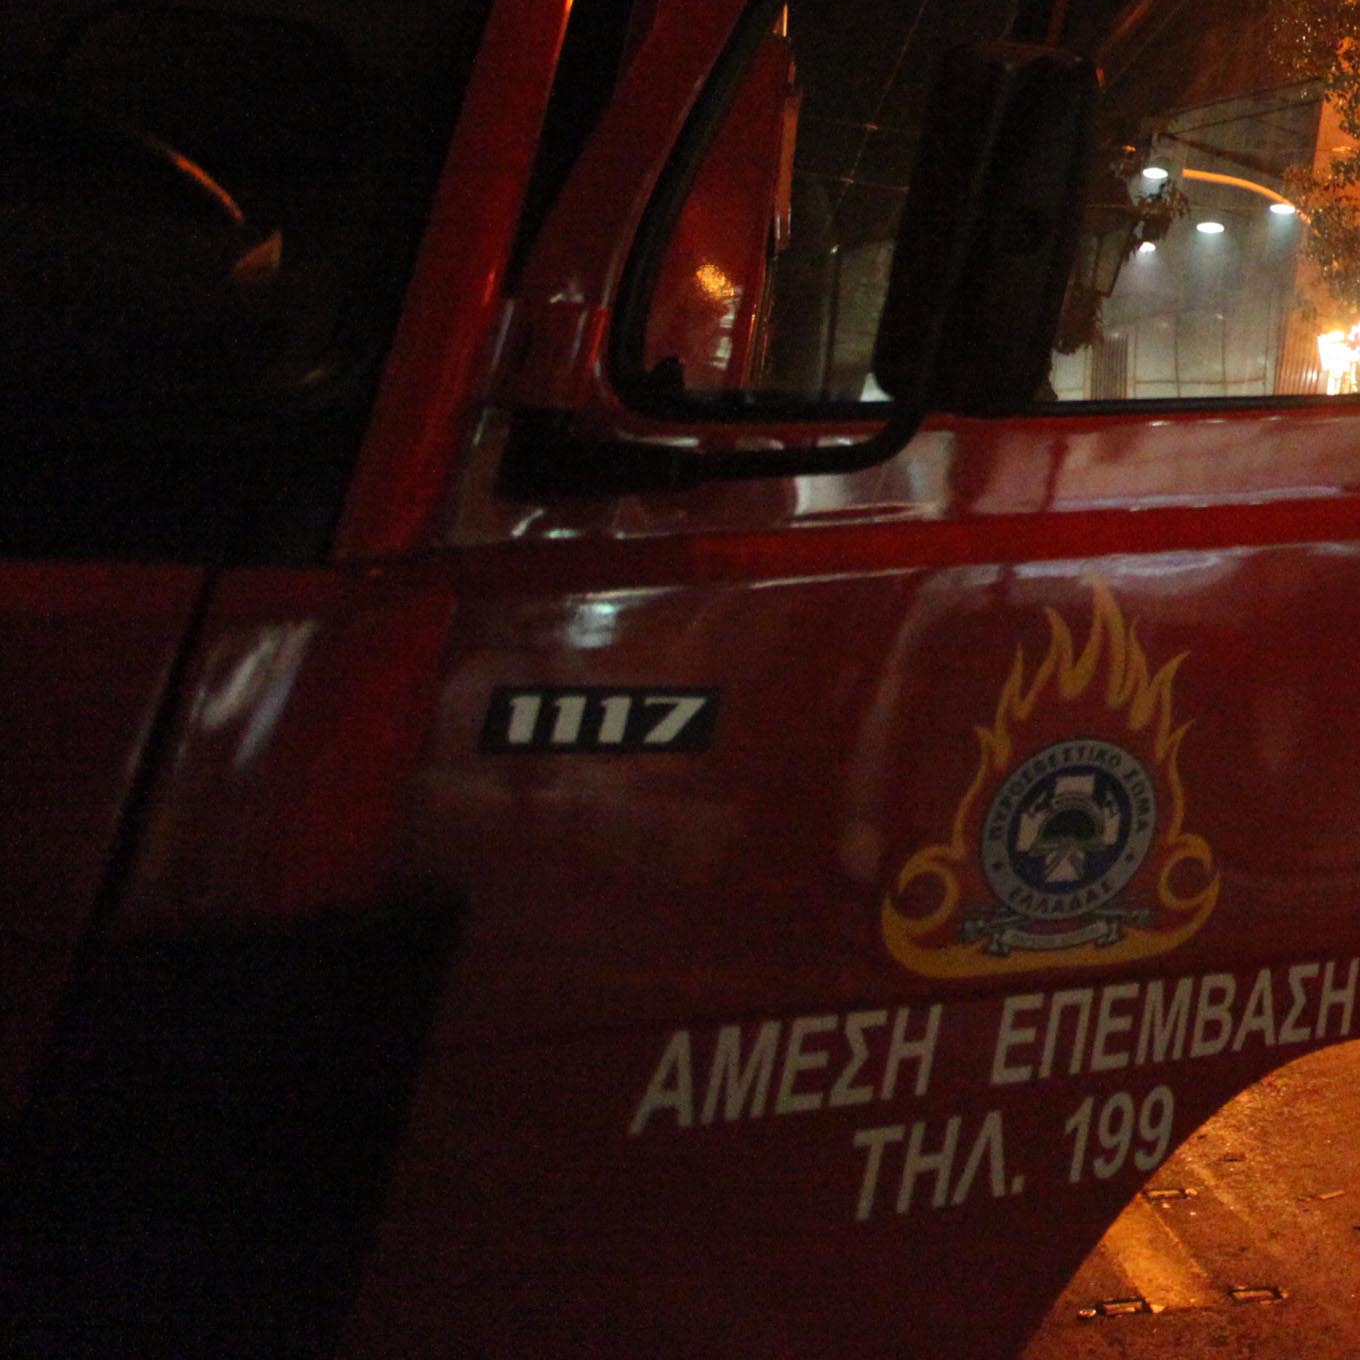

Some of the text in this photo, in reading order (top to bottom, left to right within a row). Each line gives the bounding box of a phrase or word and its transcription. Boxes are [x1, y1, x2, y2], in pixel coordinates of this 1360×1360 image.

[506, 695, 707, 744] 1117
[630, 958, 1360, 1135] ΑΜΕΣΗ ΕΠΕΜΒΑΣΗ
[852, 1085, 1175, 1222] ΤΗΛ. 199
